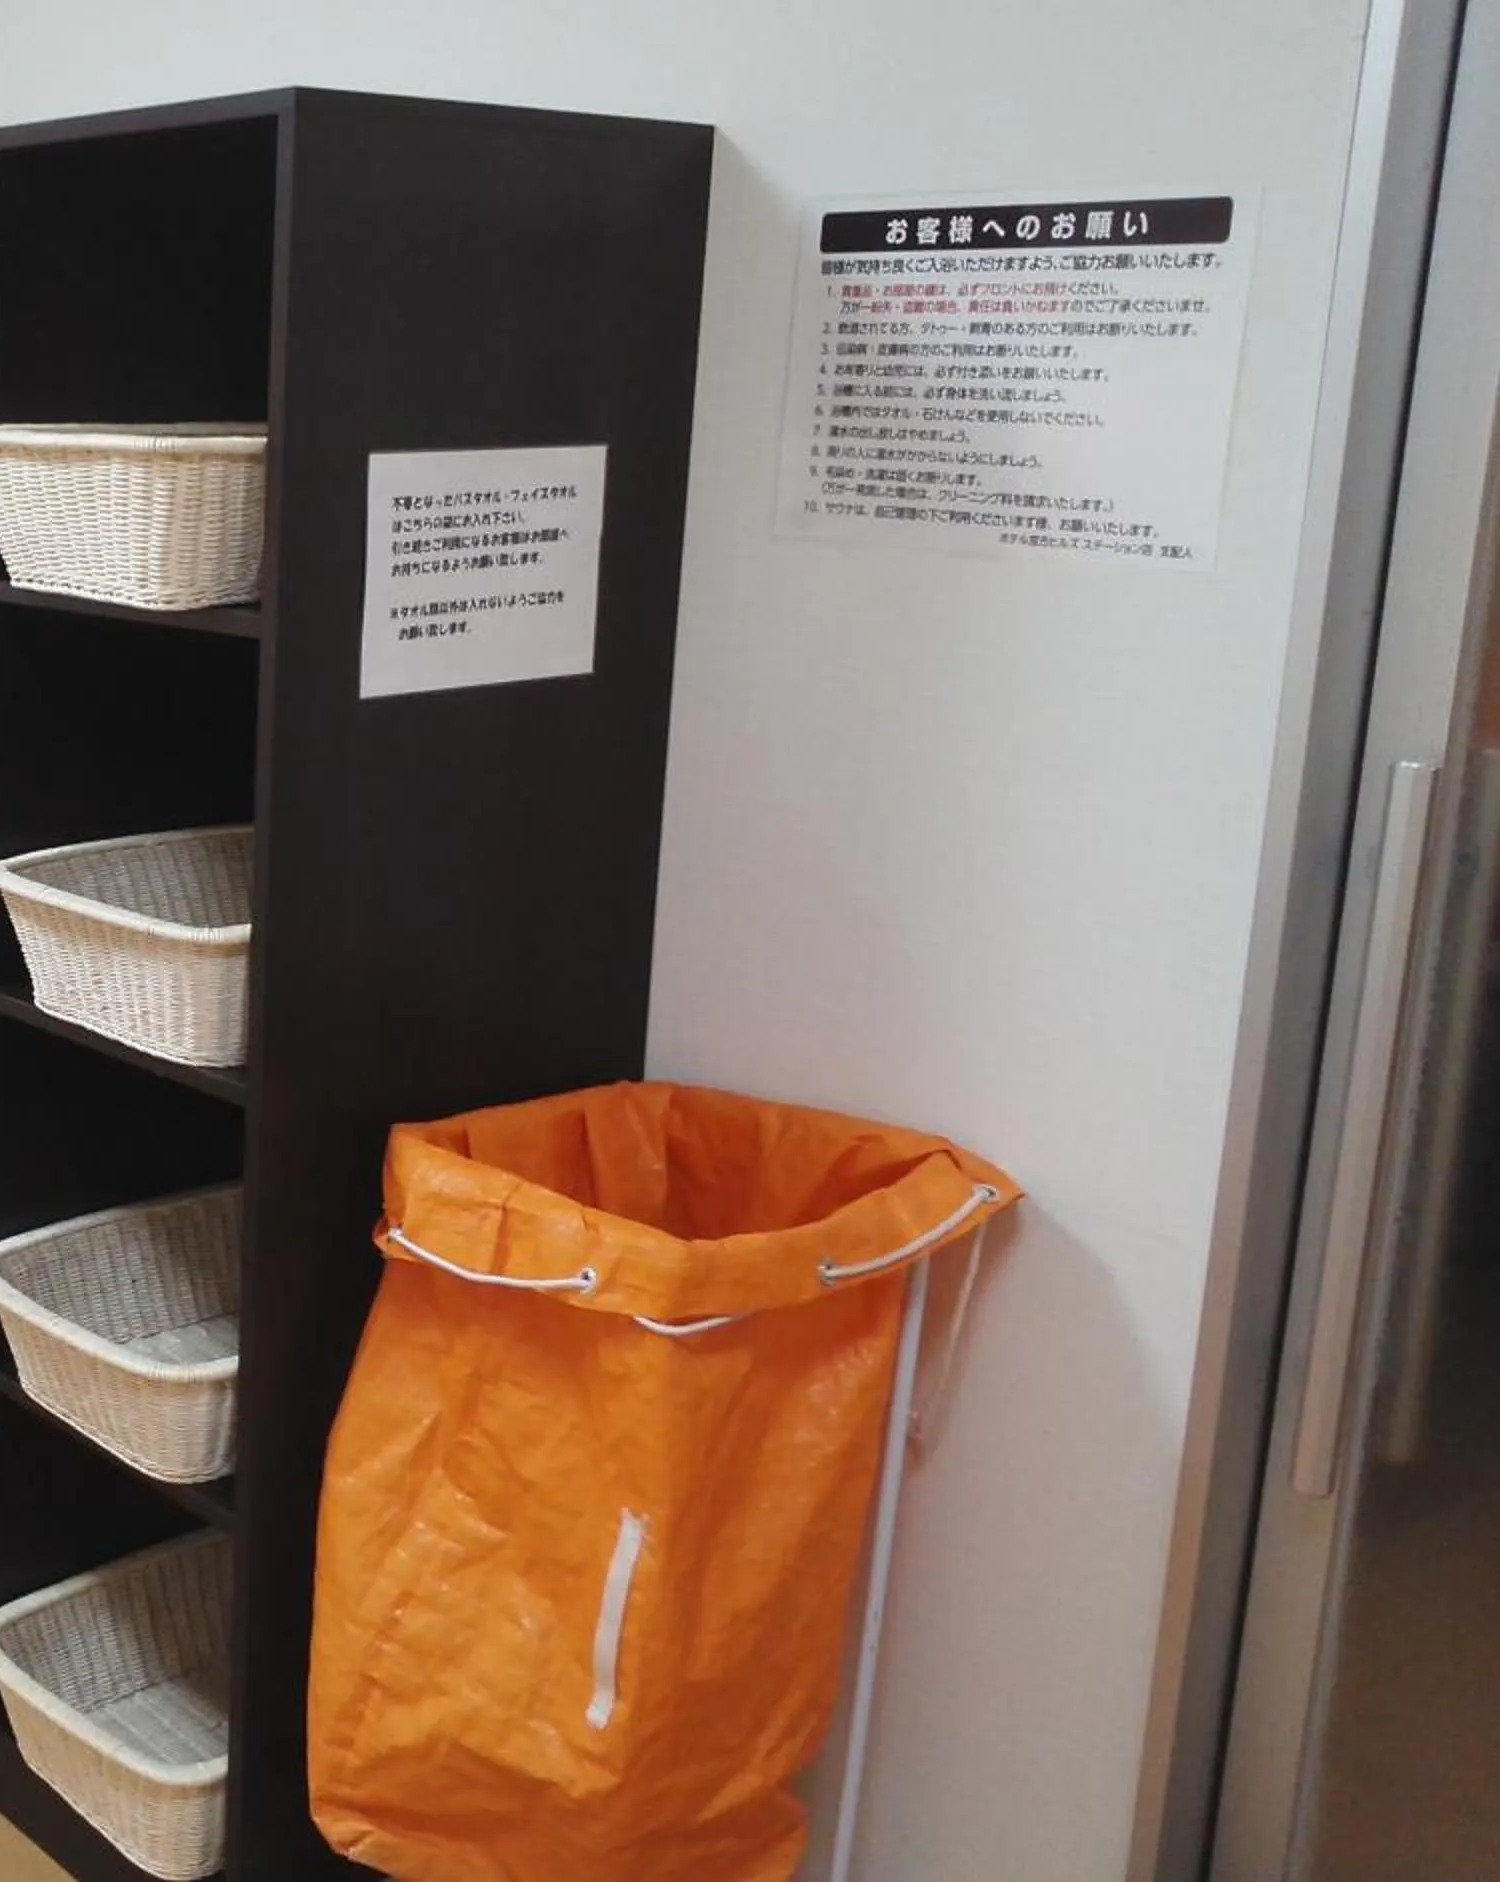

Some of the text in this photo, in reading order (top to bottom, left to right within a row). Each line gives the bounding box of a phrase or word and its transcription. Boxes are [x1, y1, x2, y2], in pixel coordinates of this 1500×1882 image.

[885, 211, 1148, 244] お客様へのお願い
